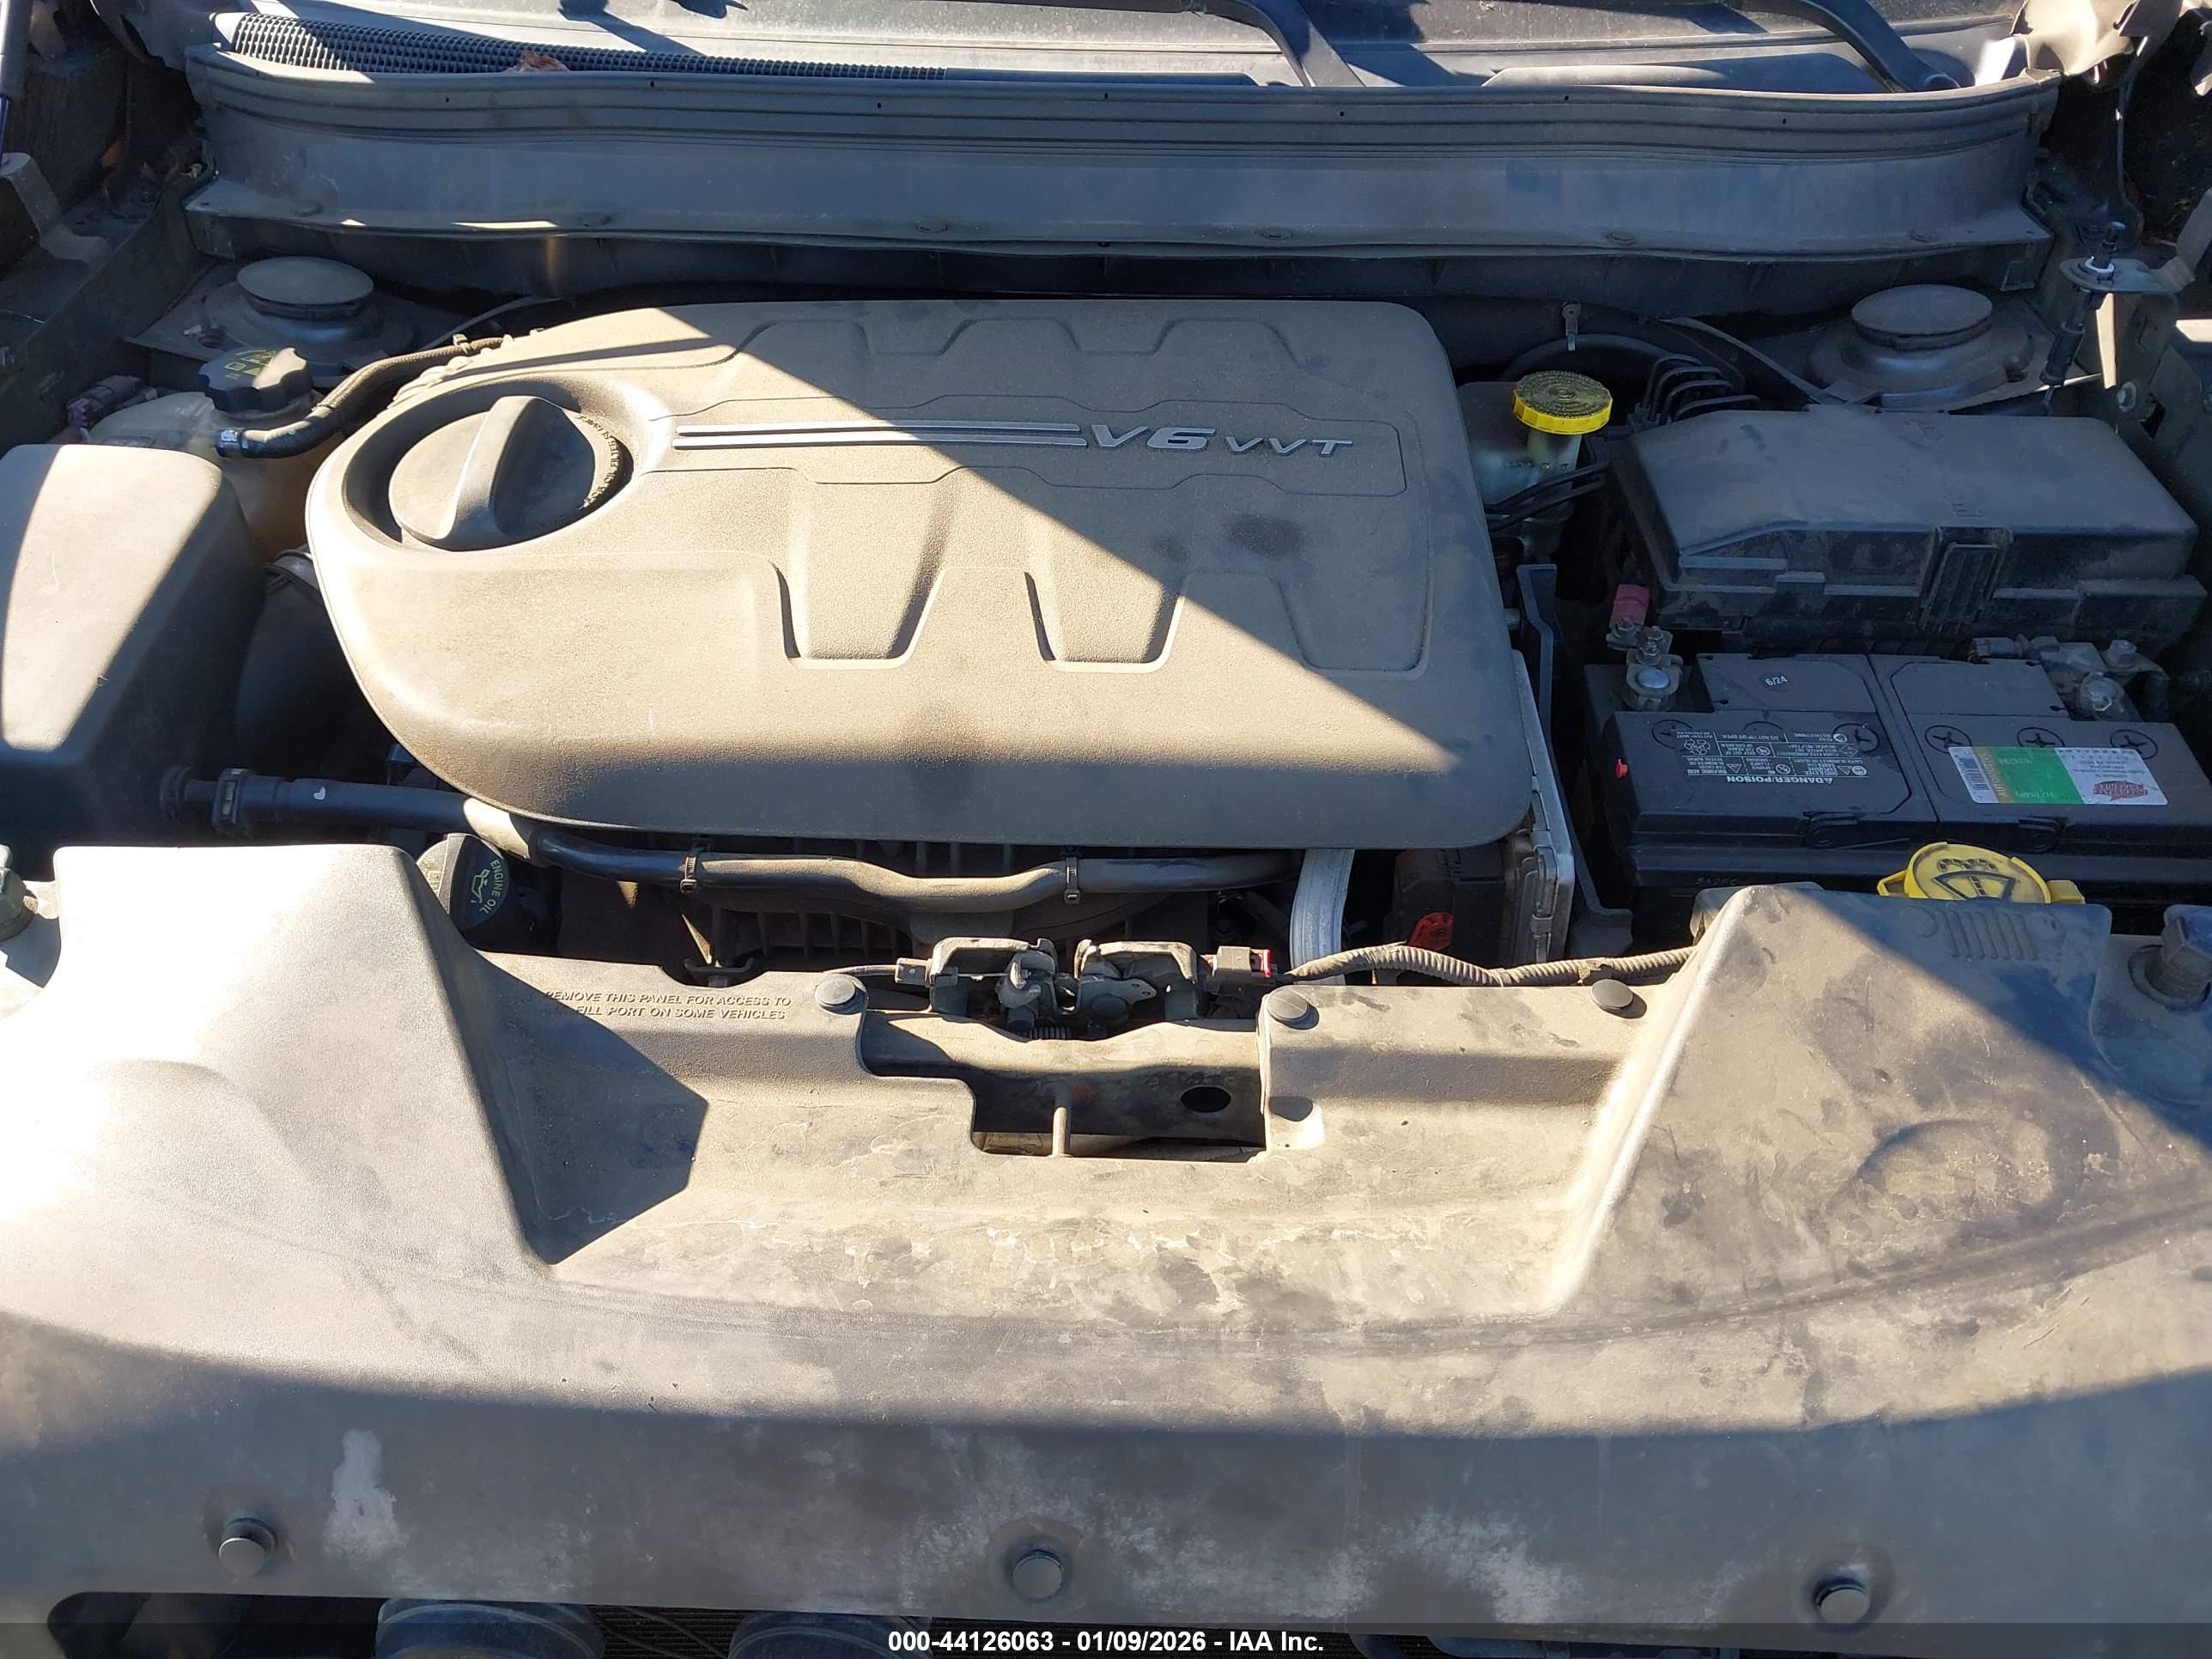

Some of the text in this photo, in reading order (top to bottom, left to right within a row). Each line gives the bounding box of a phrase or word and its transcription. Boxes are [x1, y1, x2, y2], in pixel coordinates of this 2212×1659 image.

[1091, 424, 1353, 457] V6 VVT
[1765, 675, 1788, 686] 6/24
[1726, 775, 1825, 784] DANGER/POISON
[480, 860, 504, 914] ENGINE OIL
[606, 993, 635, 1003] THIS
[639, 994, 682, 1004] PANEL
[686, 995, 714, 1005] FOR
[716, 996, 769, 1006] ACCESS
[775, 998, 792, 1006] TO
[608, 1007, 646, 1017] PORT
[650, 1008, 672, 1018] ON
[674, 1009, 714, 1018] SOME
[720, 1010, 786, 1019] VEHICLES
